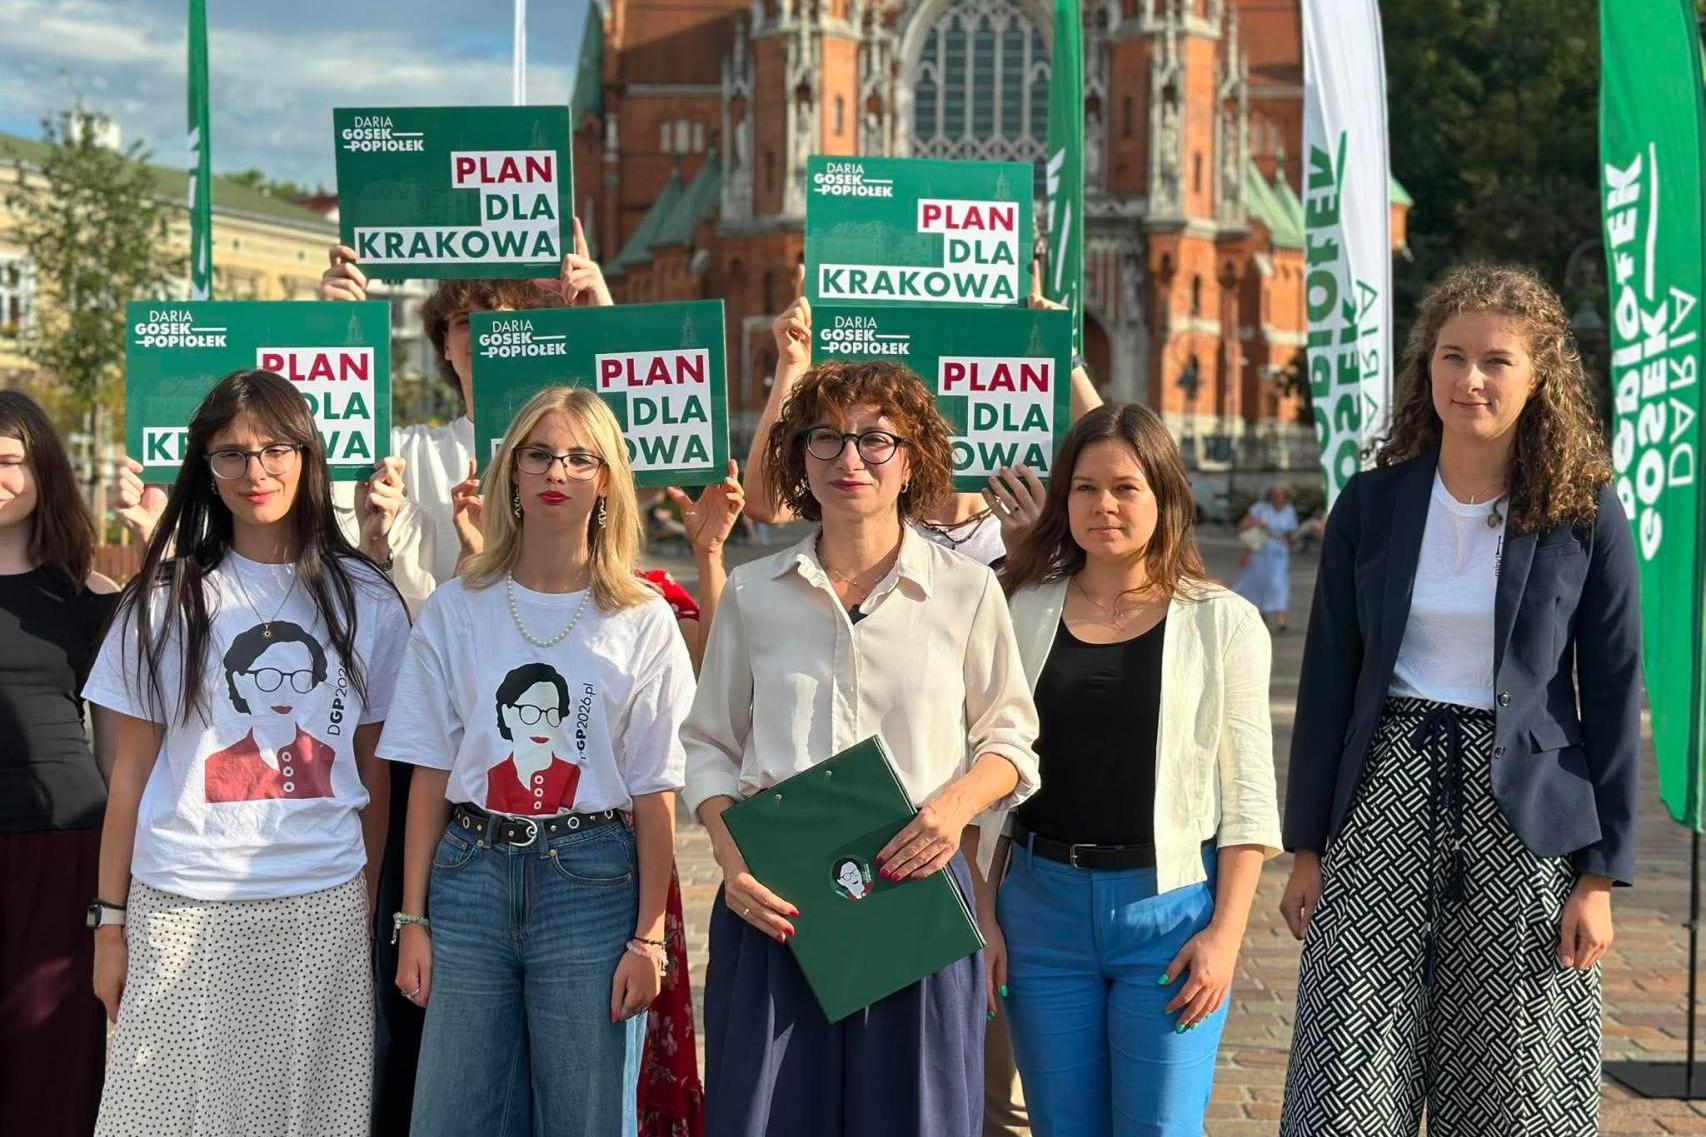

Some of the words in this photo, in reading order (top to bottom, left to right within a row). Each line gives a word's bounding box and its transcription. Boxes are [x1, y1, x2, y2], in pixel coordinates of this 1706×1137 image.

[354, 116, 393, 128] DARIA
[456, 156, 552, 184] PLAN
[827, 162, 864, 174] DARIA
[486, 193, 555, 220] DLA
[922, 204, 1014, 231] PLAN
[358, 230, 557, 259] KRAKOWA
[950, 239, 1014, 265] DLA
[823, 268, 1015, 299] KRAKOWA
[150, 310, 193, 322] DARIA
[492, 319, 533, 333] DARIA
[835, 316, 878, 328] DARIA
[262, 353, 369, 381] PLAN
[601, 354, 704, 388] PLAN
[943, 362, 1049, 392] PLAN
[633, 395, 708, 426] DLA
[973, 403, 1049, 432] DLA
[327, 664, 348, 736] DGP202
